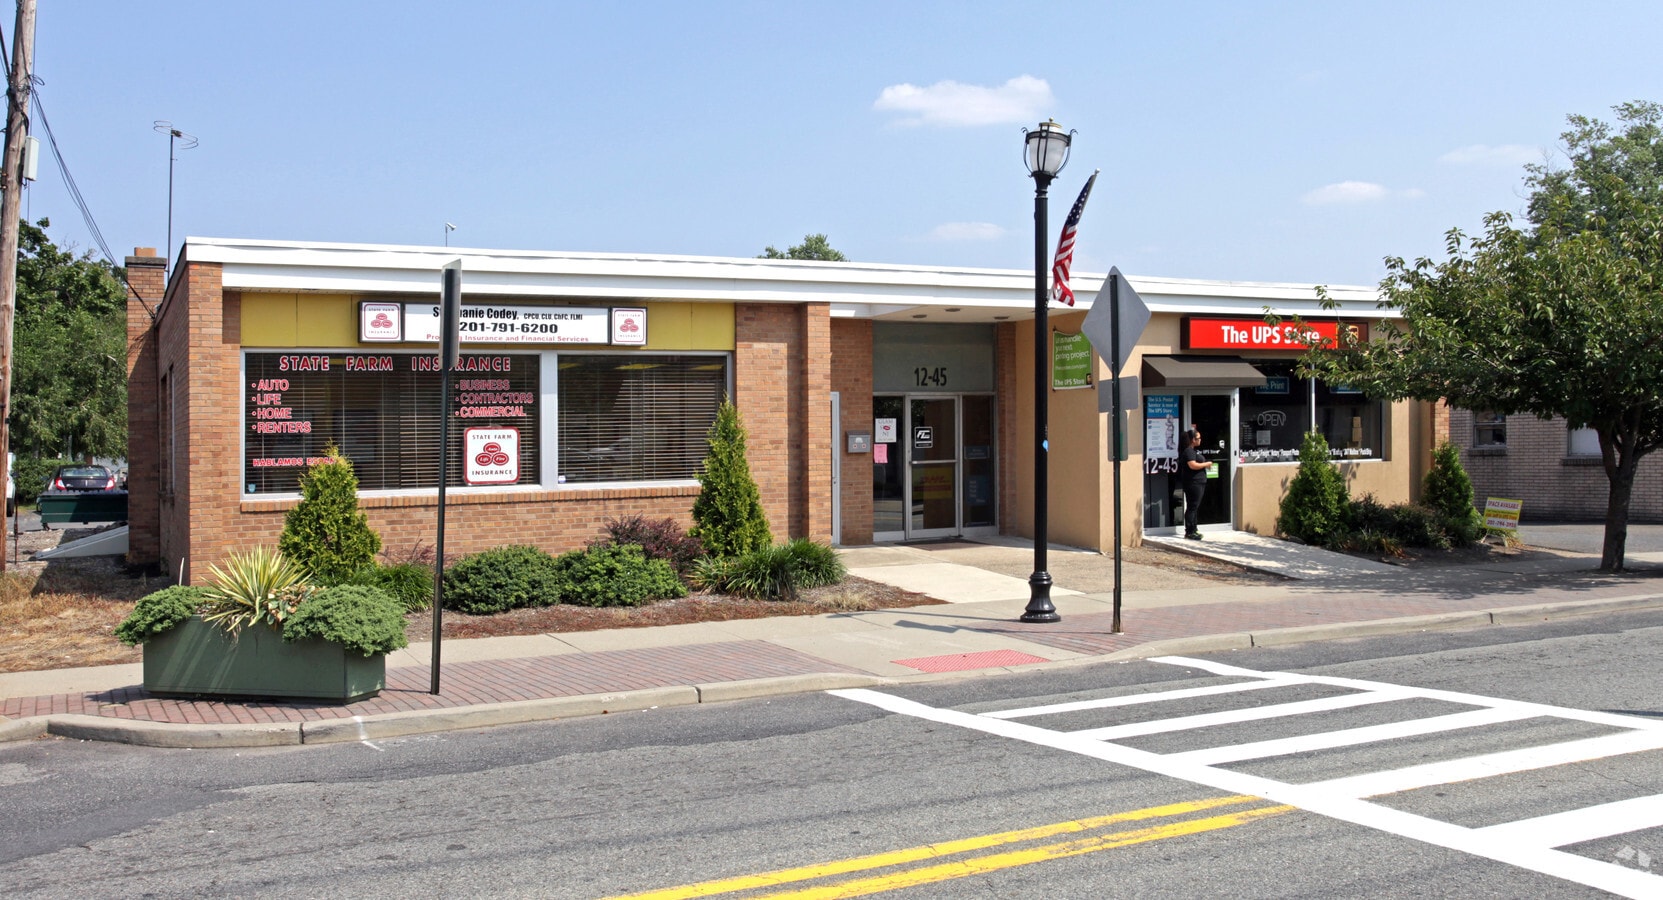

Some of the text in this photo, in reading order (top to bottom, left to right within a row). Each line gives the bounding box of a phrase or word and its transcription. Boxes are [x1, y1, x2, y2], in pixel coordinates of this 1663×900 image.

[432, 306, 485, 318] Sanie
[486, 308, 520, 320] Codey,
[459, 322, 558, 333] 201-791-6200
[1221, 326, 1320, 344] The UPS Stre
[1070, 351, 1090, 361] project
[280, 356, 511, 371] STATE FARM INSRANCE
[914, 367, 947, 387] 12-45
[257, 379, 289, 391] AUTO
[460, 379, 510, 390] BUSINESS
[256, 393, 281, 405] LIFE
[460, 392, 534, 404] CONTRACTORS
[256, 408, 292, 419] HOME
[460, 406, 526, 418] COMMERCIAL
[1257, 413, 1285, 426] OPEN
[256, 422, 311, 433] RENTERS
[253, 458, 304, 467] HABLAMOS
[1144, 457, 1179, 474] 12-45
